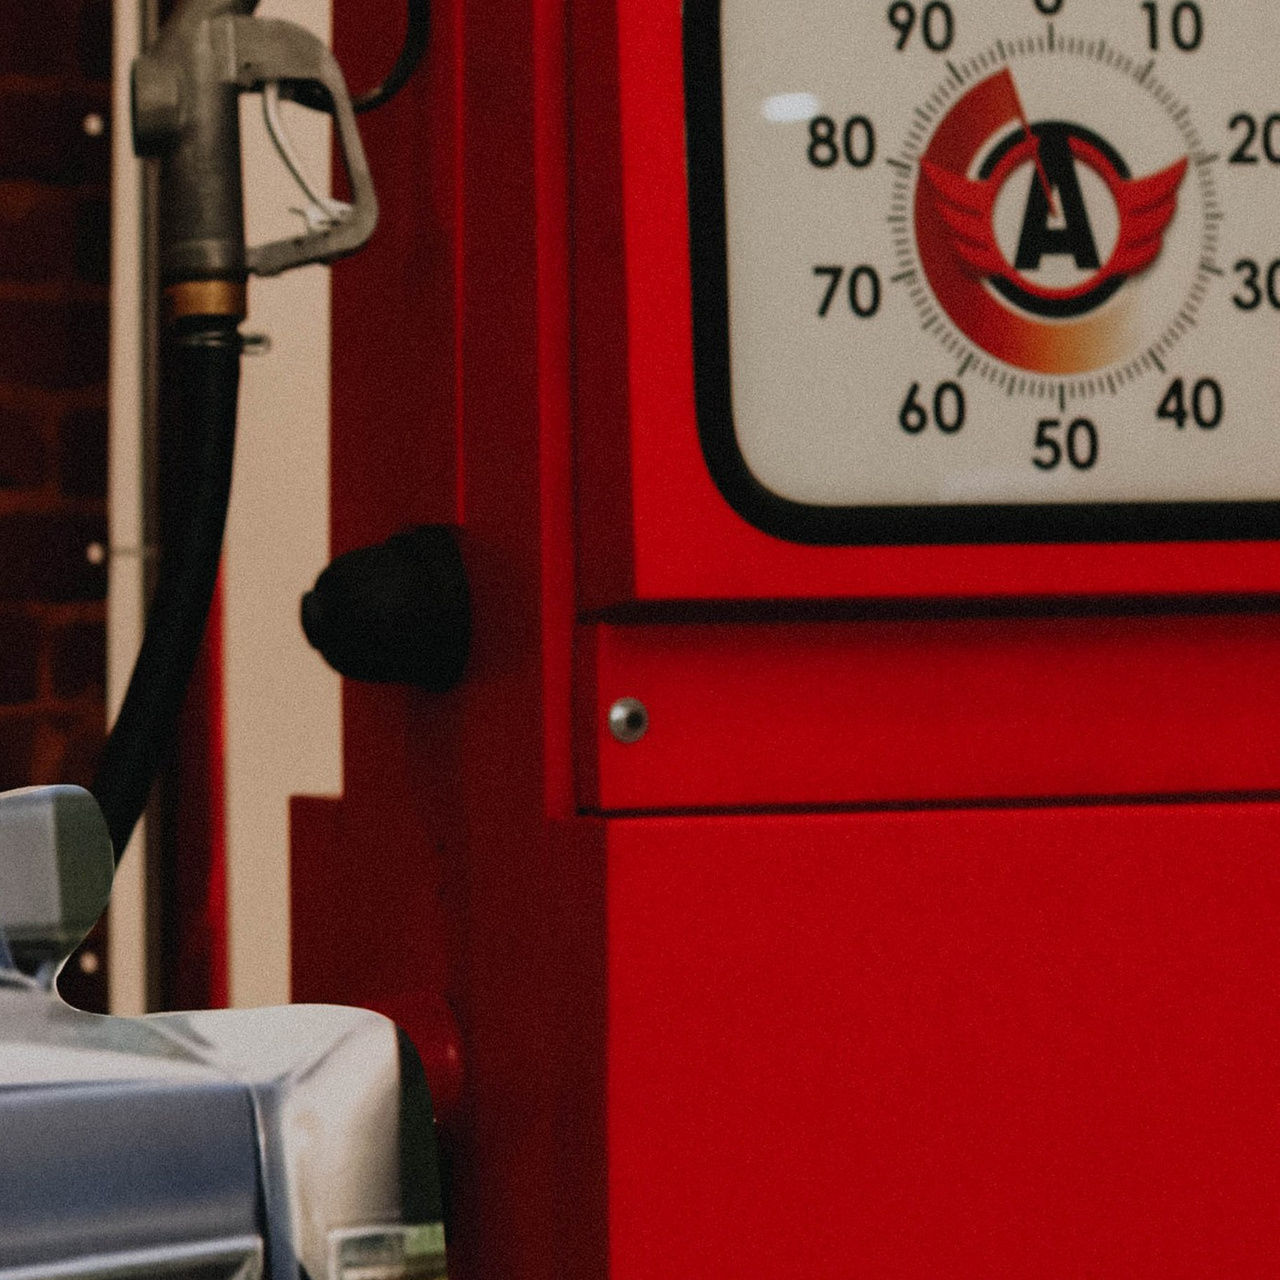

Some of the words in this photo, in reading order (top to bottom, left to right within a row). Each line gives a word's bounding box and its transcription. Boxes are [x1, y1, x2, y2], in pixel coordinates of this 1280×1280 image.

[887, 0, 955, 52] 90
[1141, 0, 1204, 52] 10
[807, 115, 876, 168] 80
[813, 265, 881, 319] 70
[899, 380, 966, 434] 60
[1157, 378, 1224, 430] 40
[1032, 417, 1099, 470] 50
